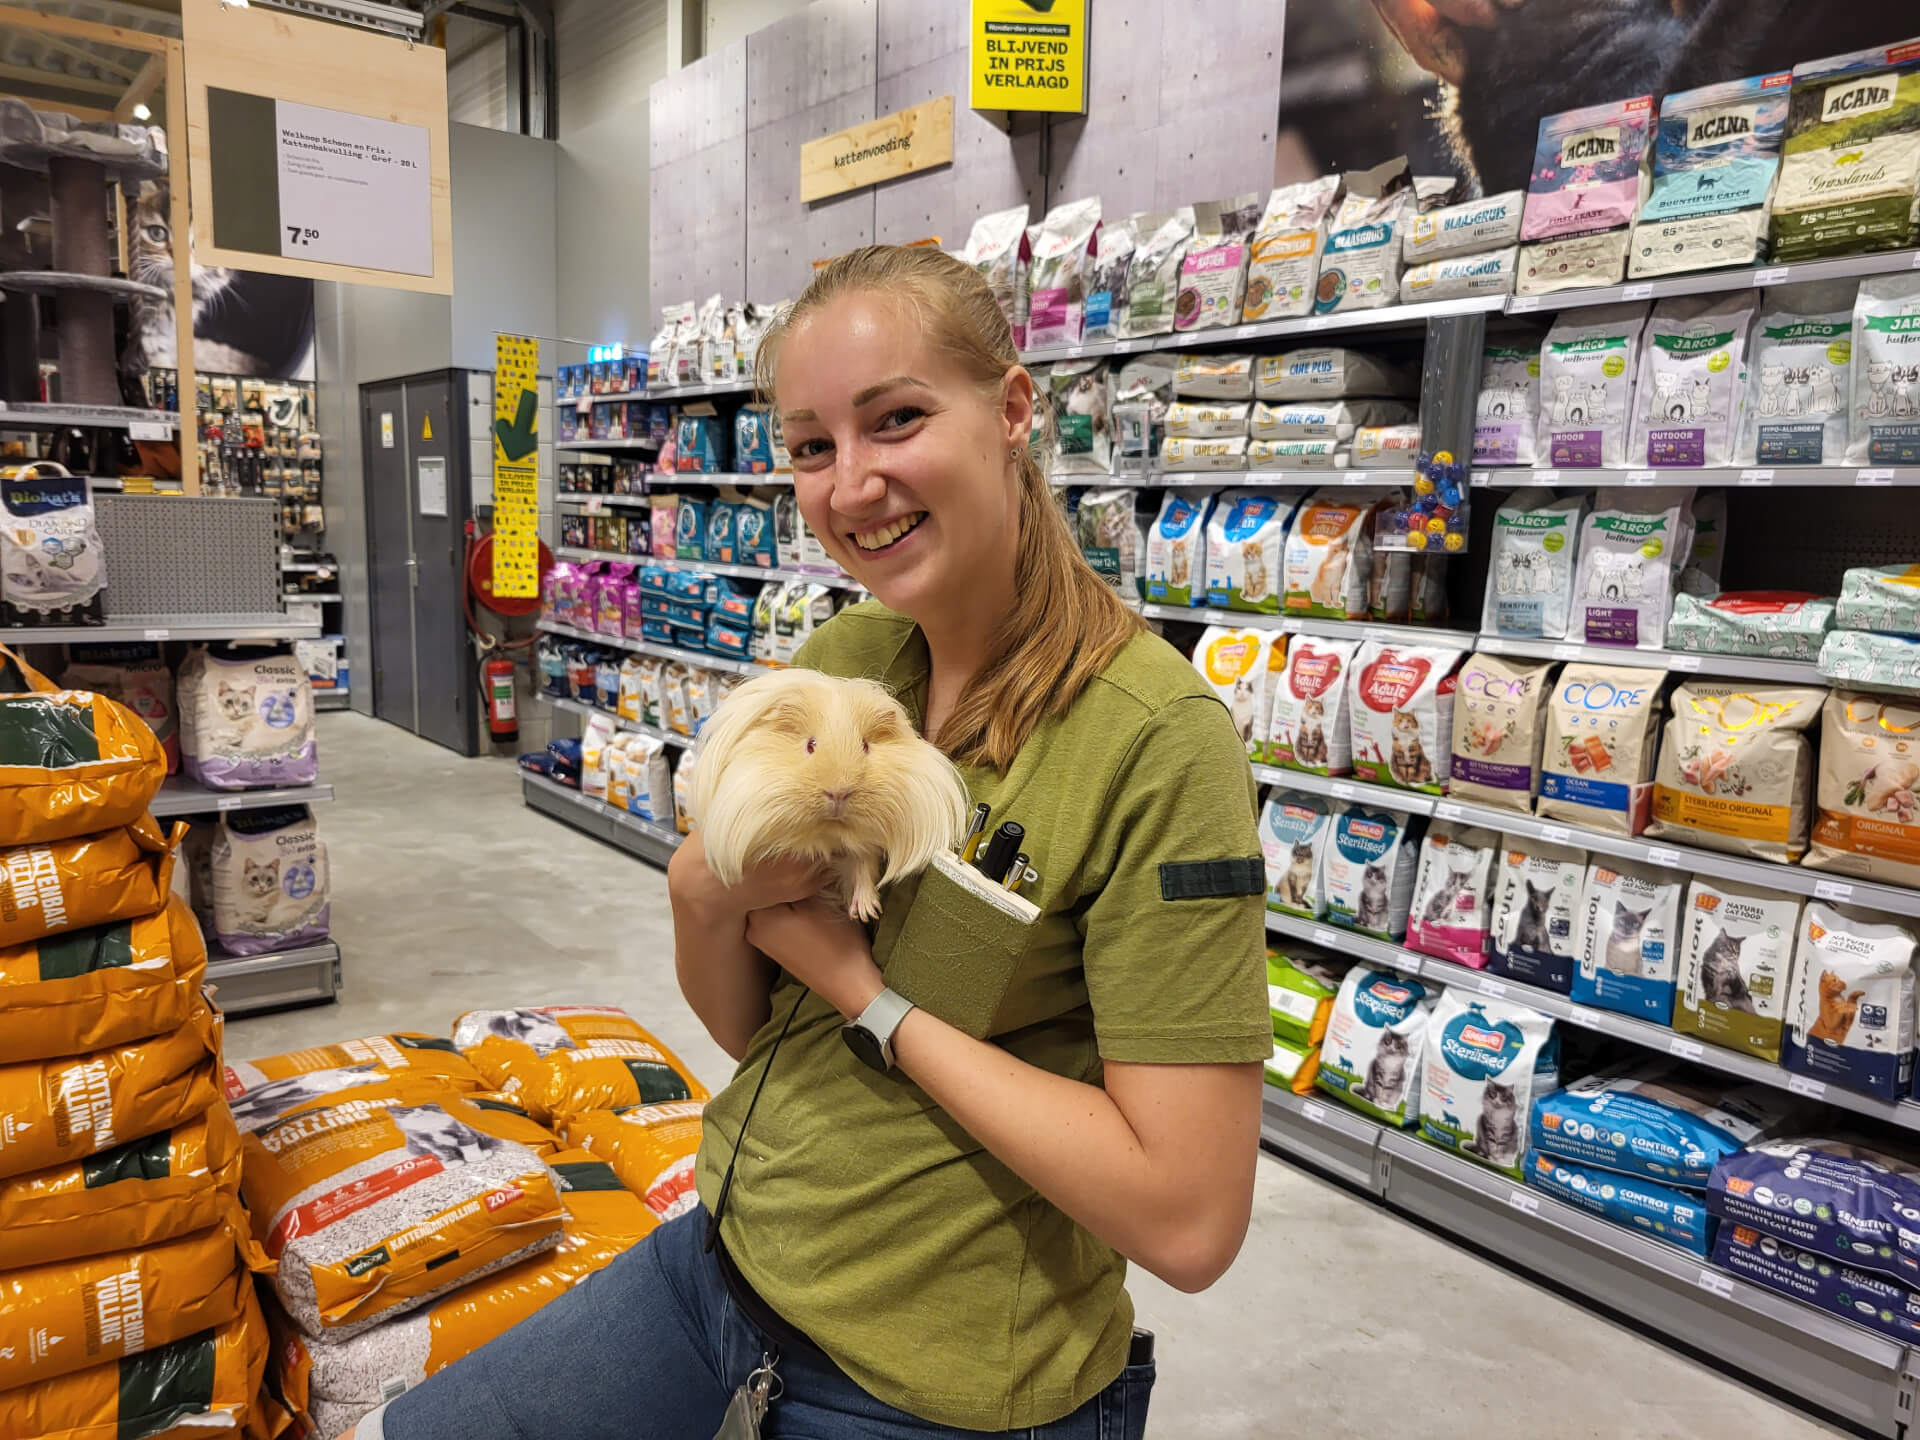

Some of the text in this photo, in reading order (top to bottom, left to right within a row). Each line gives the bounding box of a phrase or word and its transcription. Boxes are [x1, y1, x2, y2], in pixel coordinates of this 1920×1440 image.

[987, 40, 1068, 55] BLIJVEND
[989, 57, 1065, 72] IN PRIJS
[984, 74, 1069, 89] VERLAAGD
[1827, 87, 1889, 115] ACANA
[1692, 115, 1750, 141] ACANA
[282, 129, 321, 143] Welkoop
[322, 137, 352, 149] Schoon
[366, 145, 385, 154] Fris
[282, 138, 363, 159] Kattenbakvulling
[834, 133, 912, 168] kattenvoeding
[1566, 136, 1615, 161] ACANA
[1808, 165, 1886, 192] Grasslands
[1785, 325, 1833, 337] JARCO
[1570, 339, 1606, 351] JARCO
[1673, 338, 1716, 349] JARCO
[1553, 433, 1584, 442] INDOOR
[1651, 432, 1693, 441] OUTDOOR
[11, 491, 81, 506] Biokat's
[1509, 515, 1550, 527] JARCO
[1610, 520, 1652, 533] JARCO
[1588, 609, 1612, 617] LIGHT
[254, 664, 296, 674] Classic
[1367, 681, 1408, 699] Adult
[1465, 672, 1535, 698] CORE
[1564, 682, 1646, 710] CORE
[1566, 779, 1589, 788] OCEAN
[1728, 804, 1773, 816] ORIGINAL
[1856, 821, 1906, 837] ORIGINAL
[276, 832, 315, 845] Classic
[1338, 833, 1386, 853] Sterilised
[1725, 908, 1740, 916] CAT
[1726, 902, 1764, 916] NATUREL
[1583, 895, 1601, 971] CONTROL
[1686, 916, 1704, 1003] SENIOR
[1442, 1039, 1508, 1069] Sterilised
[1631, 1136, 1680, 1157] CONTROL
[394, 1160, 416, 1175] 20
[487, 1192, 506, 1209] 20
[1620, 1188, 1669, 1210] CONTROL
[1723, 1196, 1772, 1217] NATUURLIJK
[1773, 1211, 1790, 1223] HET
[389, 1201, 480, 1251] KATTENBAKVULLING
[1725, 1206, 1815, 1240] COMPLETE CAT FOOD
[1837, 1210, 1893, 1232] SENSITIVE
[1729, 1246, 1776, 1269] NATUURLIJK
[1778, 1264, 1794, 1276] HET
[1729, 1255, 1816, 1295] COMPLETE CAT FOOD
